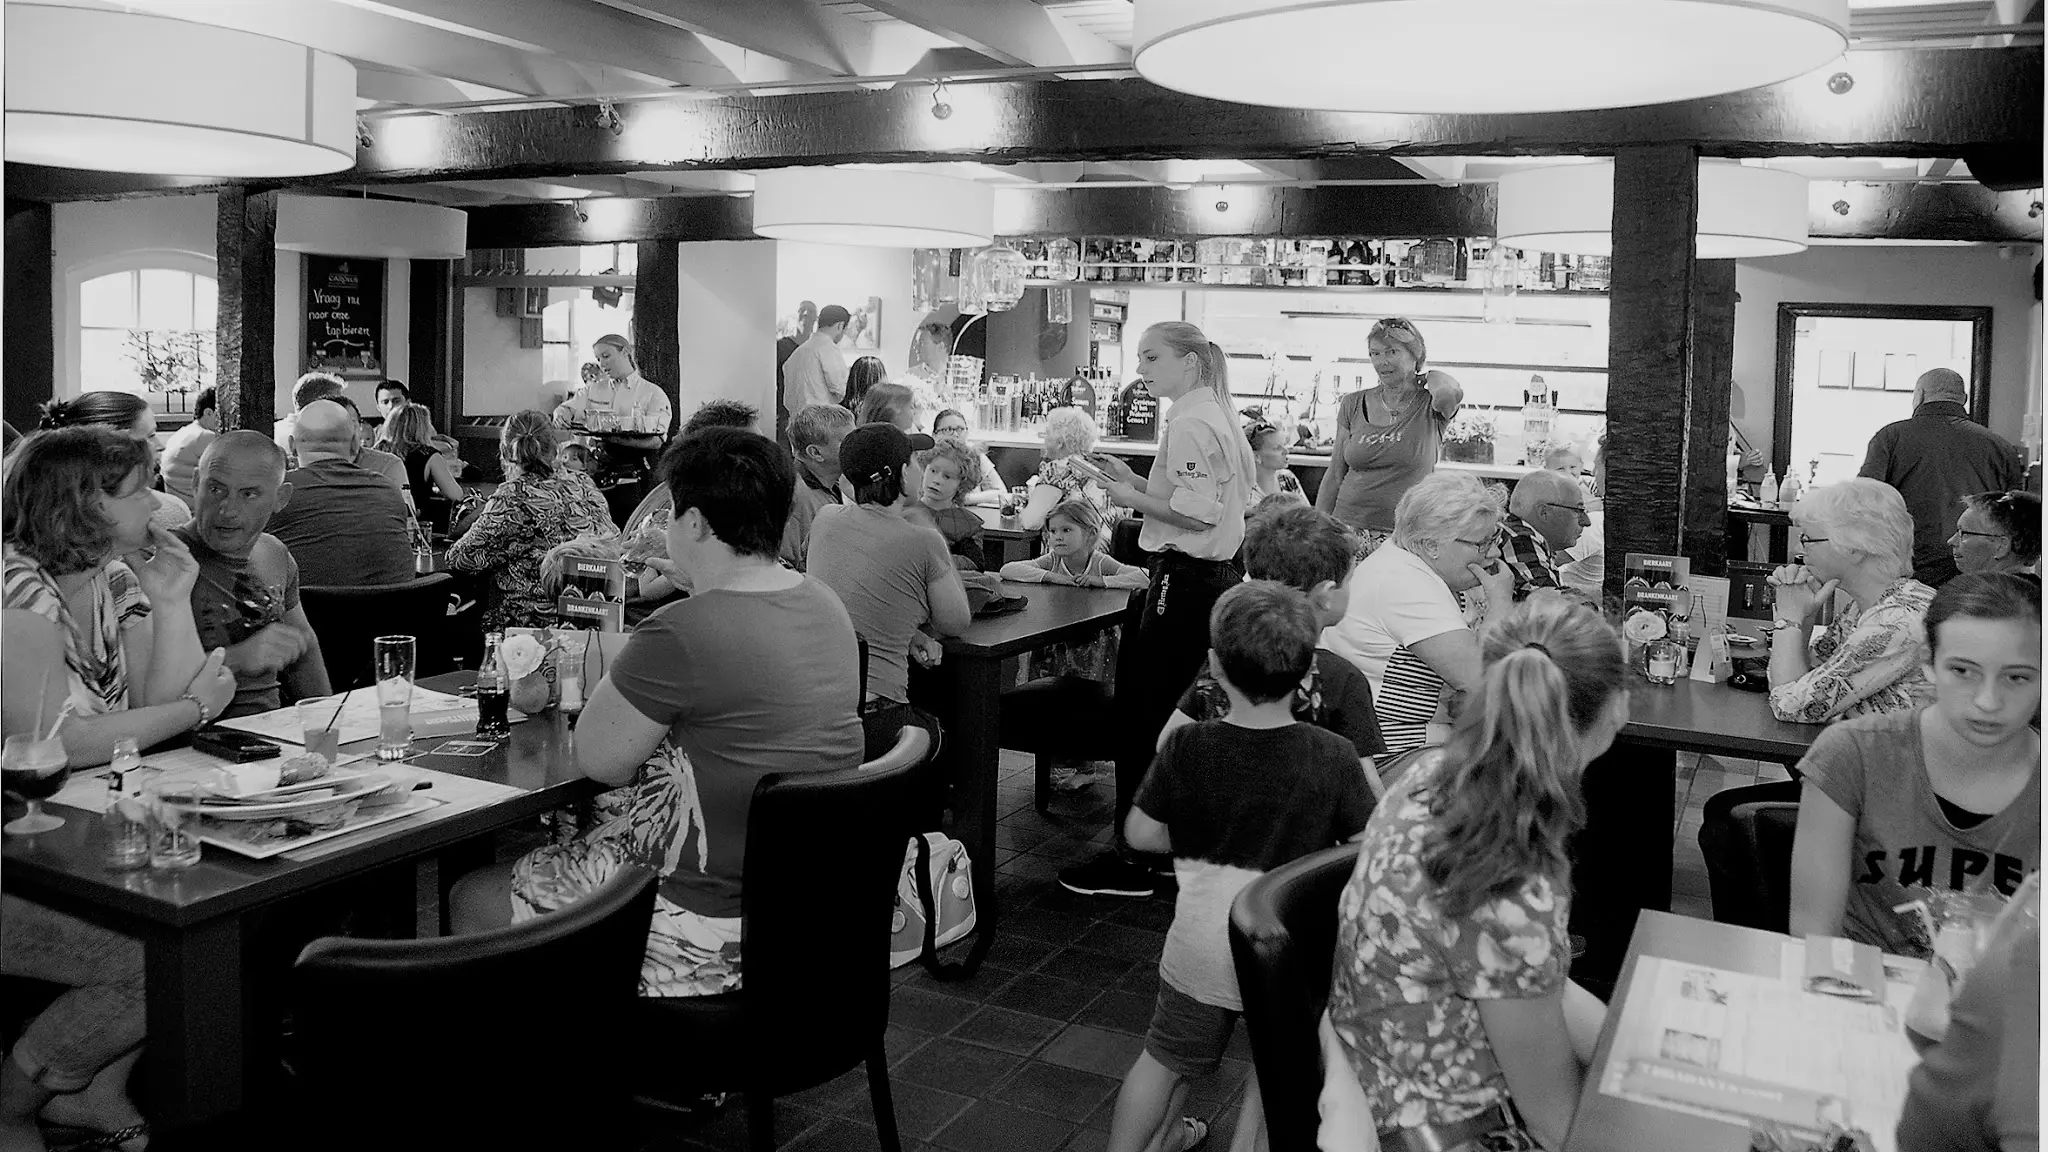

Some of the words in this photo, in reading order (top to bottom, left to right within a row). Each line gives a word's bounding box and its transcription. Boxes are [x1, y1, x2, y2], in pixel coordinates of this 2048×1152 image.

[313, 288, 340, 310] Vraag
[347, 295, 360, 305] nu
[308, 311, 329, 320] naar
[331, 311, 351, 320] onze
[577, 562, 607, 574] BIERKAART
[1643, 559, 1672, 567] BIERKAART
[1637, 591, 1679, 600] DRANKENKAART
[566, 604, 609, 616] DRANKENKAART
